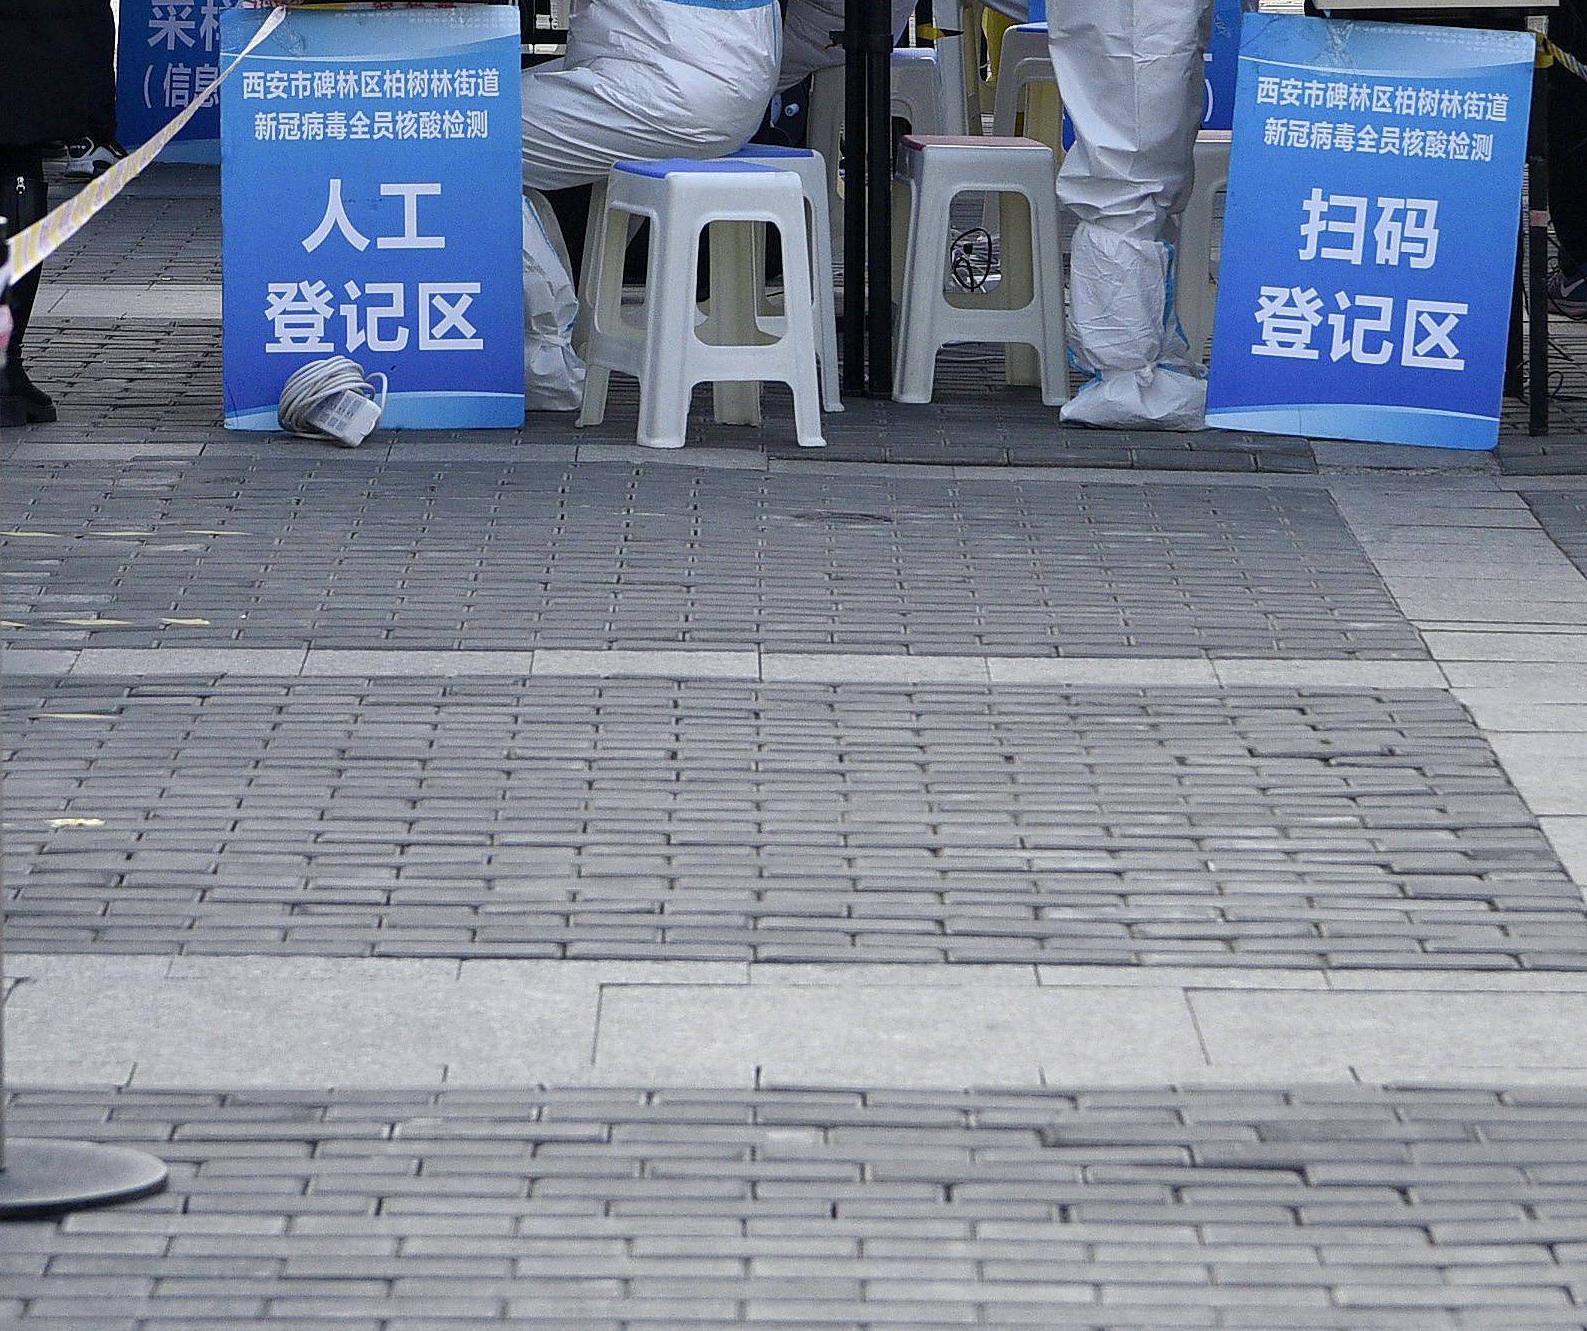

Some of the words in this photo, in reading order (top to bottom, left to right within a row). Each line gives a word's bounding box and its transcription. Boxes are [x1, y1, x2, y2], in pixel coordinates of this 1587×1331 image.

[242, 68, 500, 100] 西安市碑林区柏树林街道
[1256, 76, 1509, 122] 西安市碑林区柏树林街道
[254, 110, 489, 141] 新冠病毒全员核酸检测
[1263, 118, 1493, 162] 新冠病毒全员核酸检测
[301, 178, 446, 253] 人工
[1298, 187, 1439, 269] 扫码
[264, 279, 484, 353] 登记区
[1251, 286, 1469, 371] 登记区
